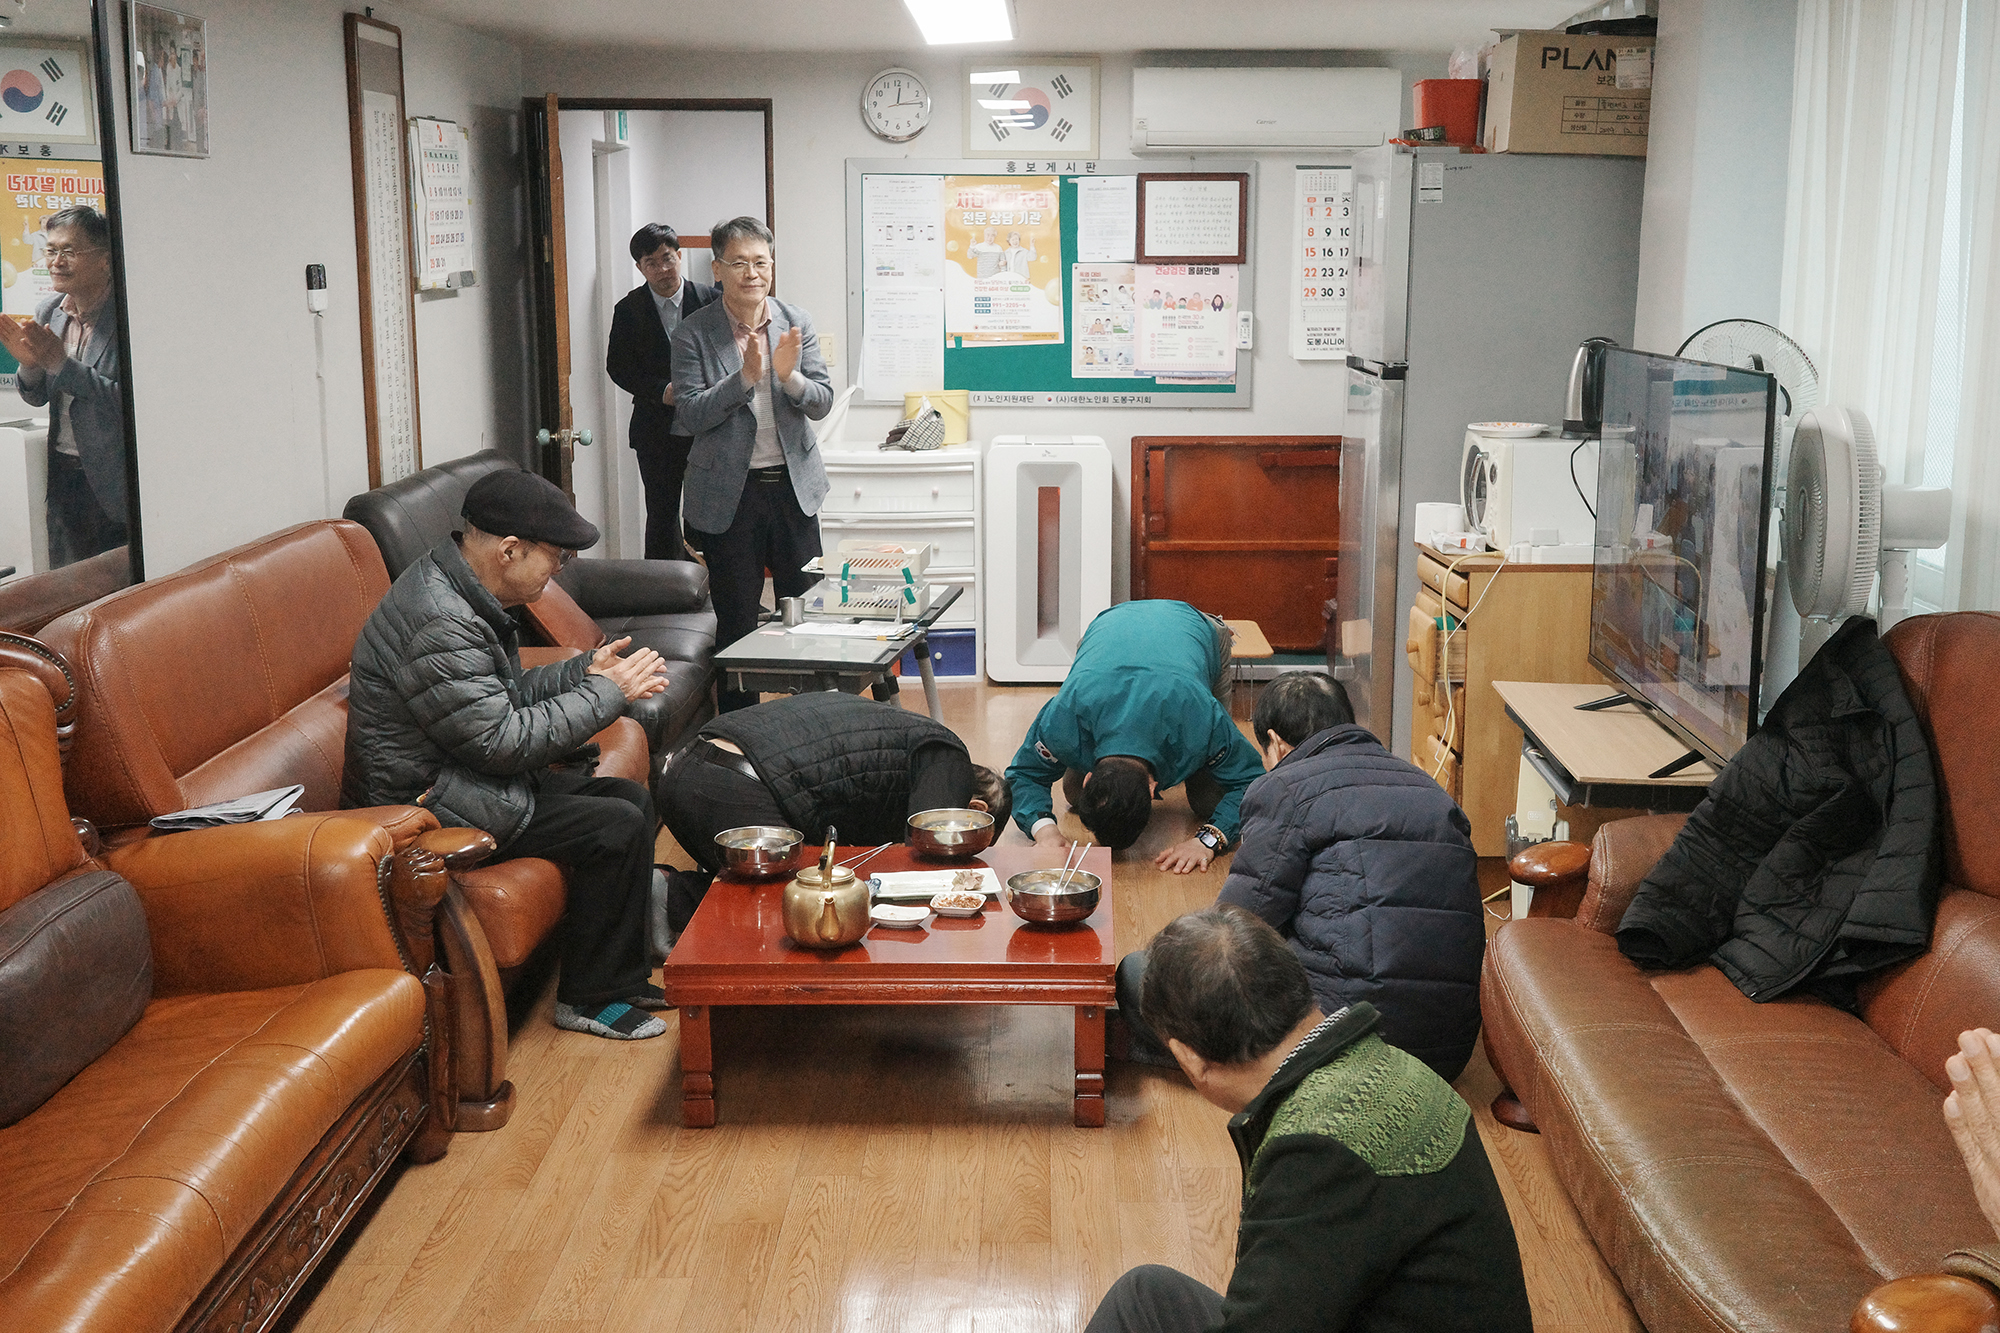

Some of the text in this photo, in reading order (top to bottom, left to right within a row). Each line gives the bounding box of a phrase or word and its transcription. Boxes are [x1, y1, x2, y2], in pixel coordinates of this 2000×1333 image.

[437, 124, 442, 142] 3
[1006, 161, 1096, 173] 홍보게시판
[1309, 207, 1349, 216] 1 2 3
[963, 211, 1042, 225] 전문 상담 기관
[1307, 228, 1314, 236] 8
[1325, 228, 1332, 236] 9
[1305, 248, 1316, 257] 15
[1322, 248, 1333, 257] 16
[1155, 267, 1186, 275] 건강검진
[1304, 268, 1317, 277] 22
[1321, 268, 1334, 277] 23
[1304, 288, 1317, 297] 29
[1321, 288, 1334, 297] 30
